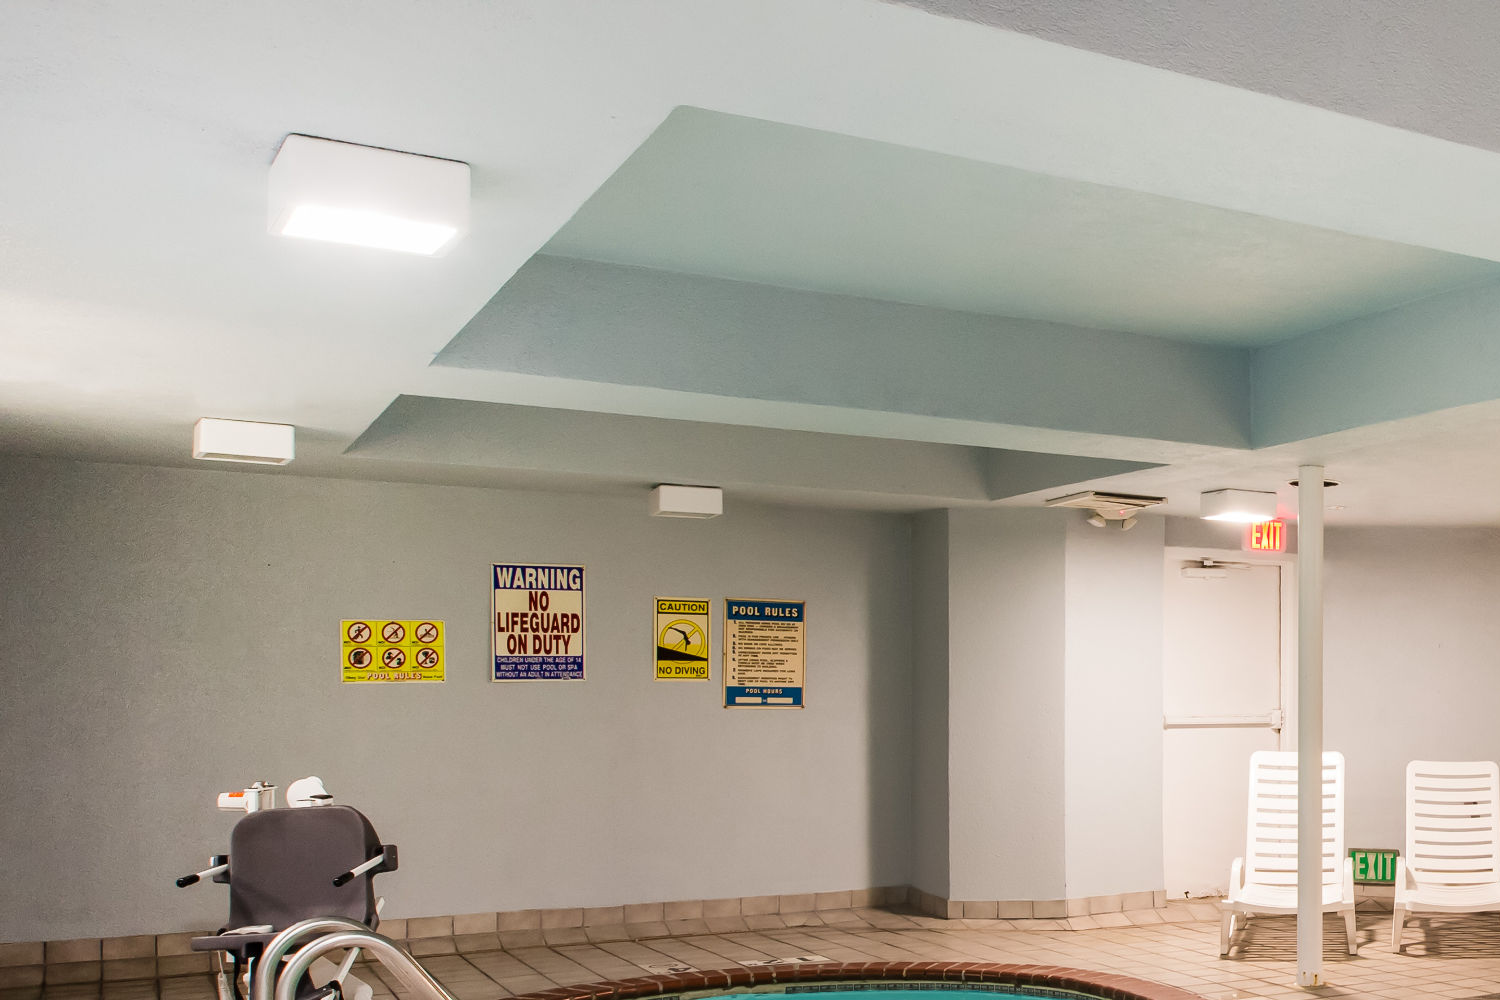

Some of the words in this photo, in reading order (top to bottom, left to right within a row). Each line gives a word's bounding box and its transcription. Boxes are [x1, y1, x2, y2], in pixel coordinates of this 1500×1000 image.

[1251, 521, 1282, 550] EXIT
[496, 567, 581, 590] WARNING
[528, 591, 549, 611] NO
[660, 602, 705, 612] CAUTION
[732, 605, 760, 616] POOL
[765, 607, 798, 617] RULES
[497, 612, 580, 633] LIFEGUARD
[507, 634, 527, 654] ON
[533, 635, 571, 654] DUTY
[367, 672, 391, 680] POOL
[394, 672, 422, 680] RULES
[659, 666, 672, 674] NO
[675, 666, 705, 675] DIVING
[1355, 852, 1394, 880] EXIT
